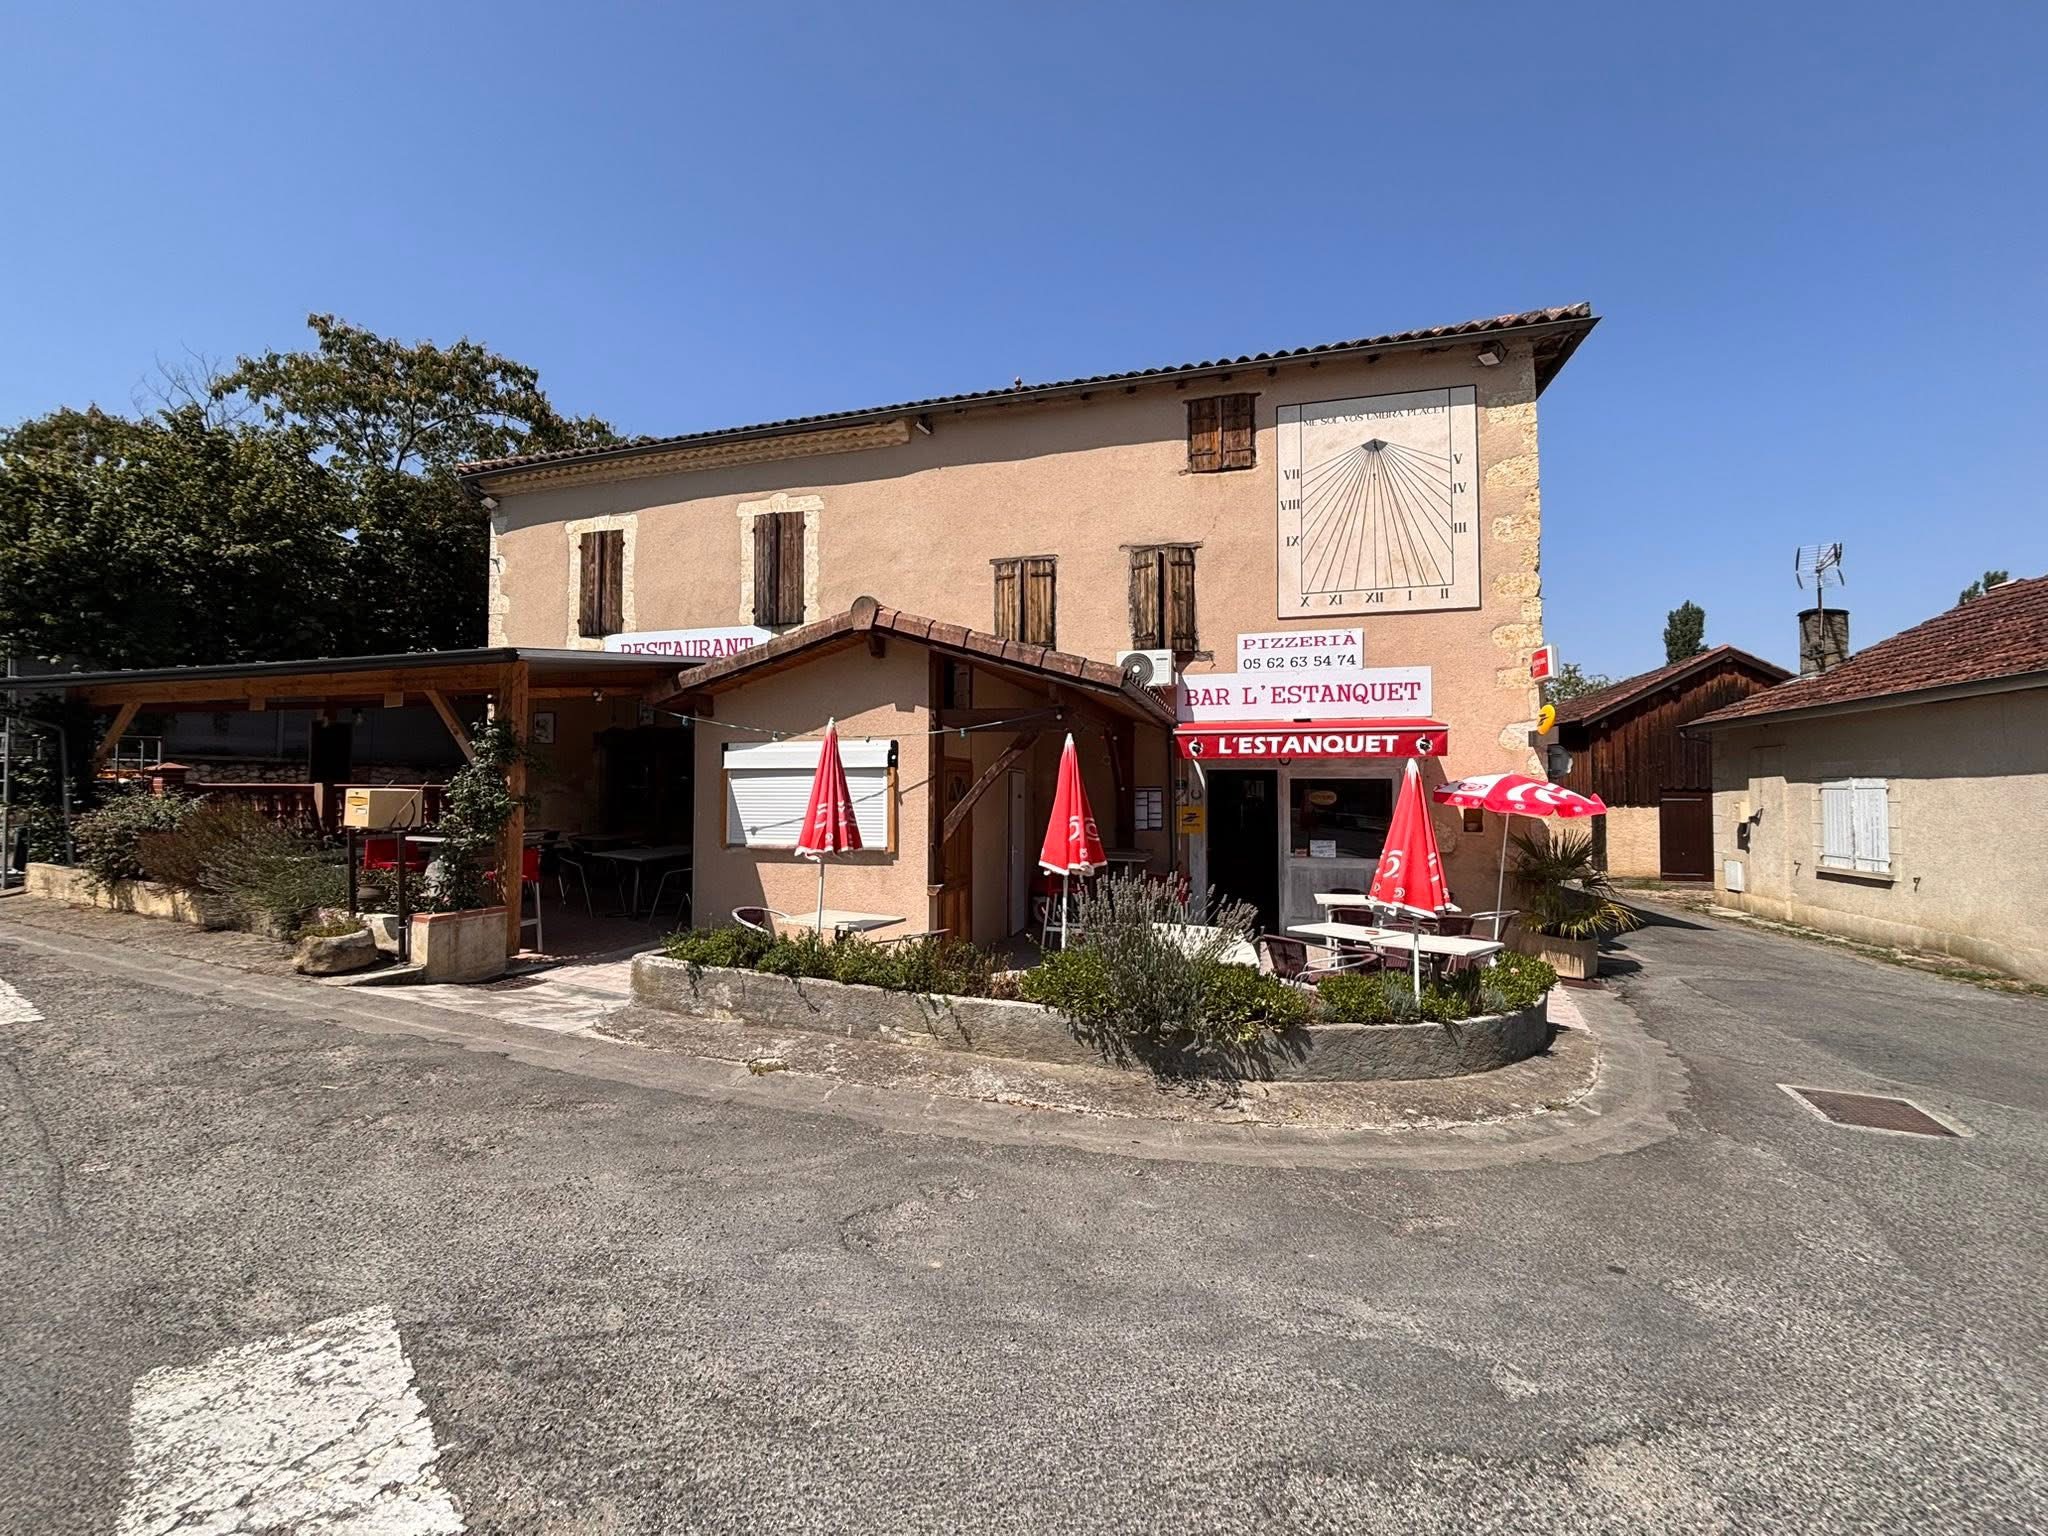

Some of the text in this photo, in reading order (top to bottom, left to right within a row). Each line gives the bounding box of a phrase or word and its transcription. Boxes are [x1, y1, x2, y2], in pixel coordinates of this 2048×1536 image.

[1343, 414, 1363, 423] VOS
[1453, 454, 1463, 464] V
[1284, 469, 1300, 480] VII
[1453, 482, 1467, 493] IV
[1280, 499, 1300, 511] VIII
[1454, 522, 1467, 533] III
[1286, 536, 1299, 547] IX
[1365, 592, 1384, 603] XII
[1440, 588, 1449, 599] II
[1300, 596, 1310, 607] X
[1329, 594, 1343, 605] XI
[620, 637, 754, 657] RESTAURANT
[1242, 634, 1357, 650] PIZZERIA
[1243, 654, 1356, 669] 05 62 63 54 74
[1185, 682, 1421, 706] BAR L'ESTANQUET
[1218, 735, 1399, 755] L'ESTANQUET
